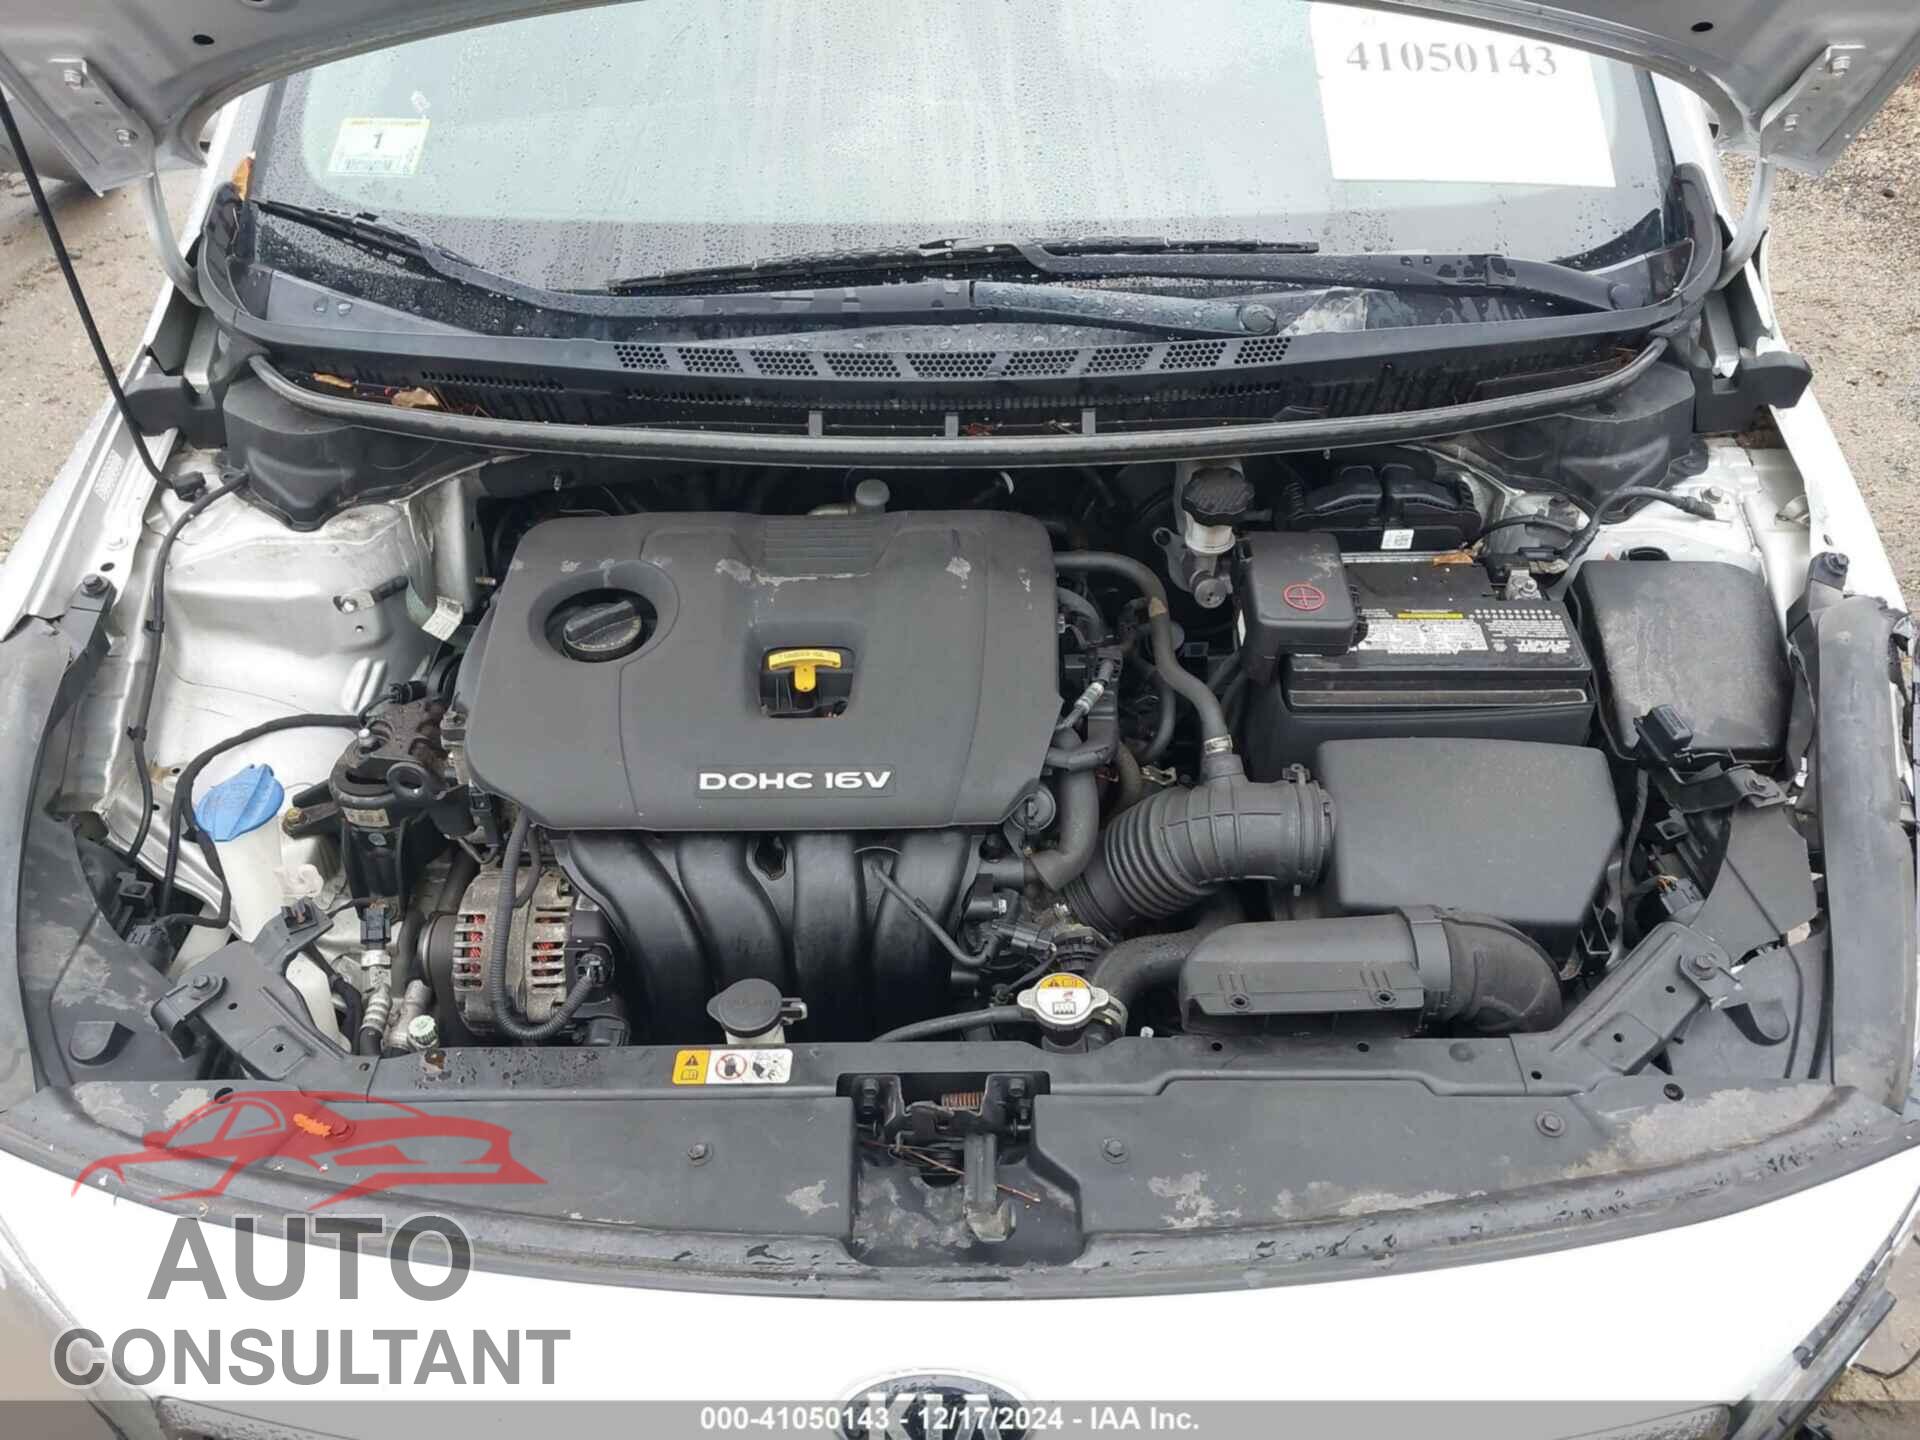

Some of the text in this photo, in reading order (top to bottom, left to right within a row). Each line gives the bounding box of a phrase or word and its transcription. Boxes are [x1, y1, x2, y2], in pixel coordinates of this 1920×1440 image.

[1346, 42, 1557, 76] 41050143
[699, 771, 891, 790] DOHC 16V
